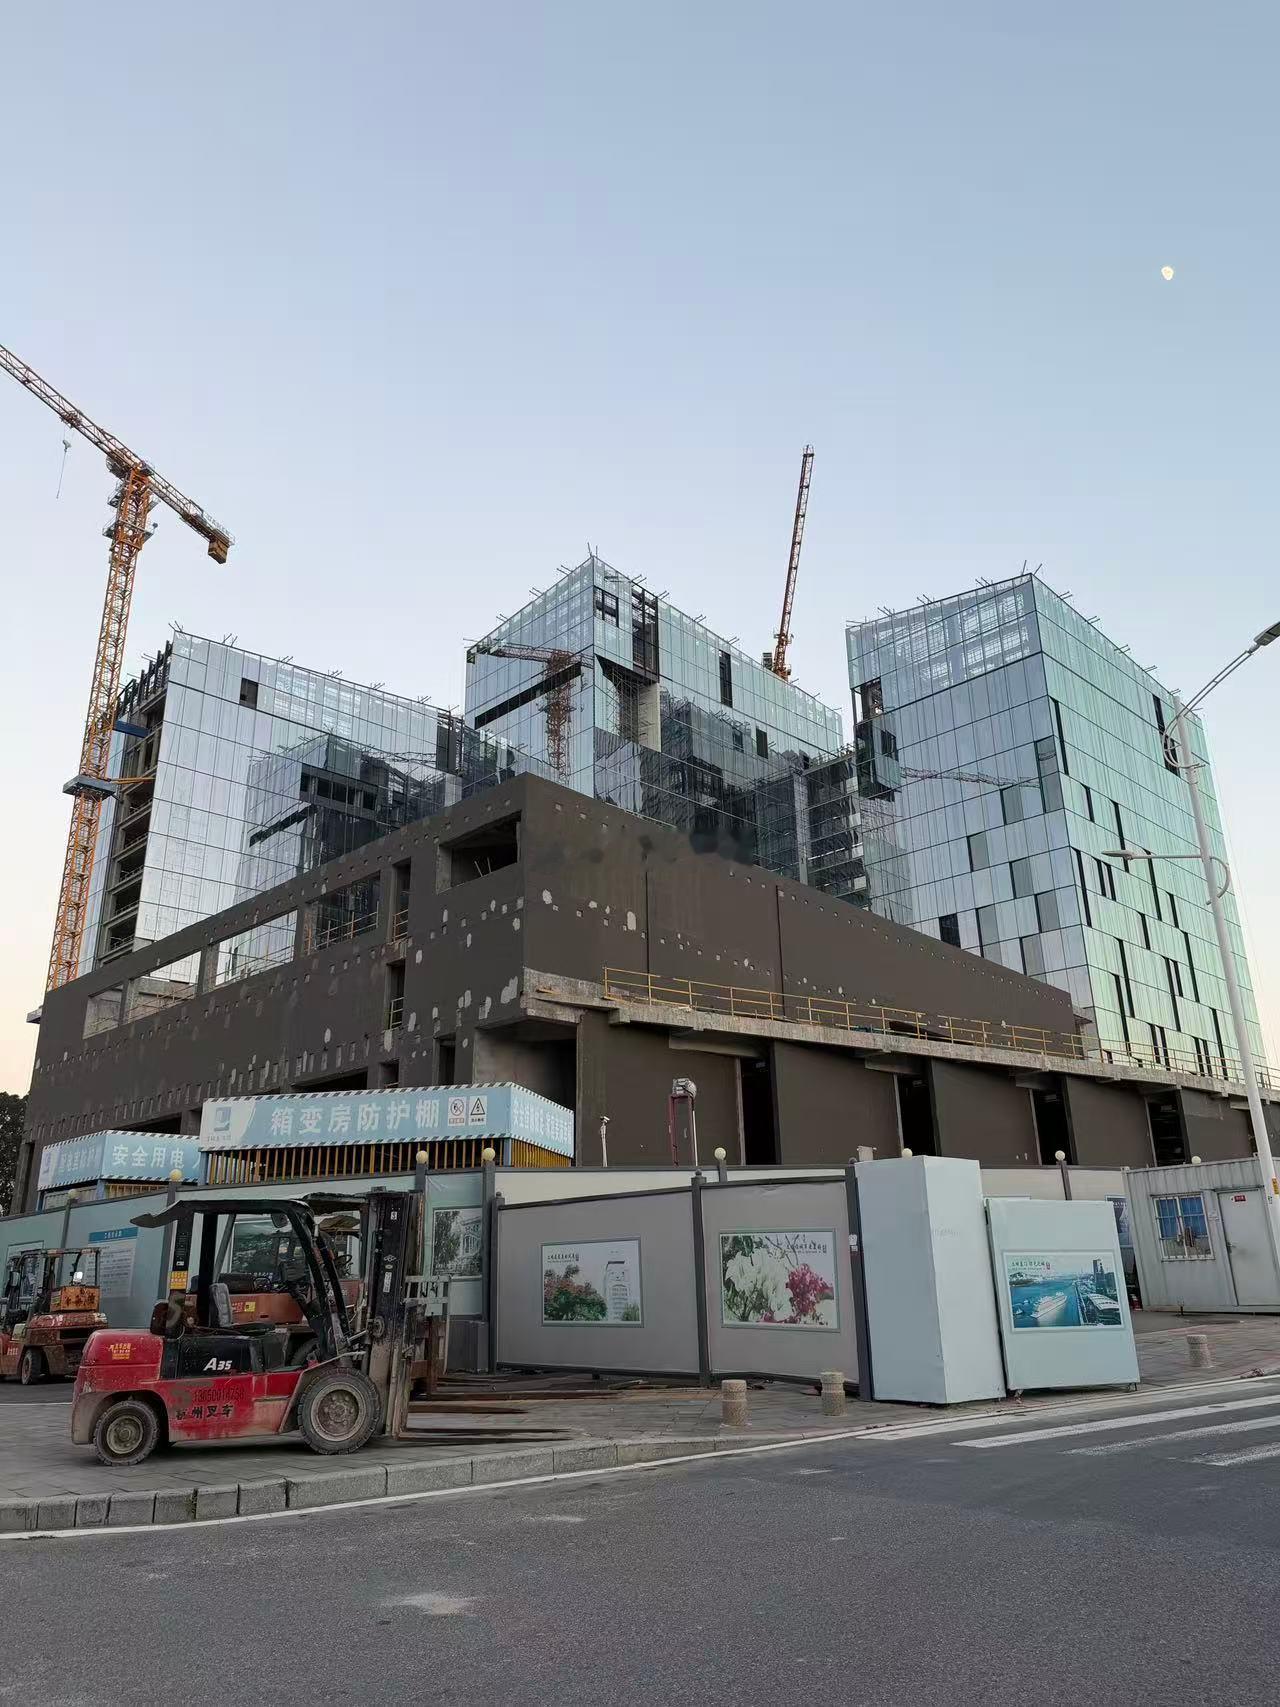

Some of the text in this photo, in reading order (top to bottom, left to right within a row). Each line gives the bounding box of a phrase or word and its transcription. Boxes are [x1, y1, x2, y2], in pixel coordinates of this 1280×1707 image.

[270, 1100, 440, 1136] 箱变房防护棚
[112, 1144, 185, 1169] 安全用电
[203, 1357, 232, 1371] A35
